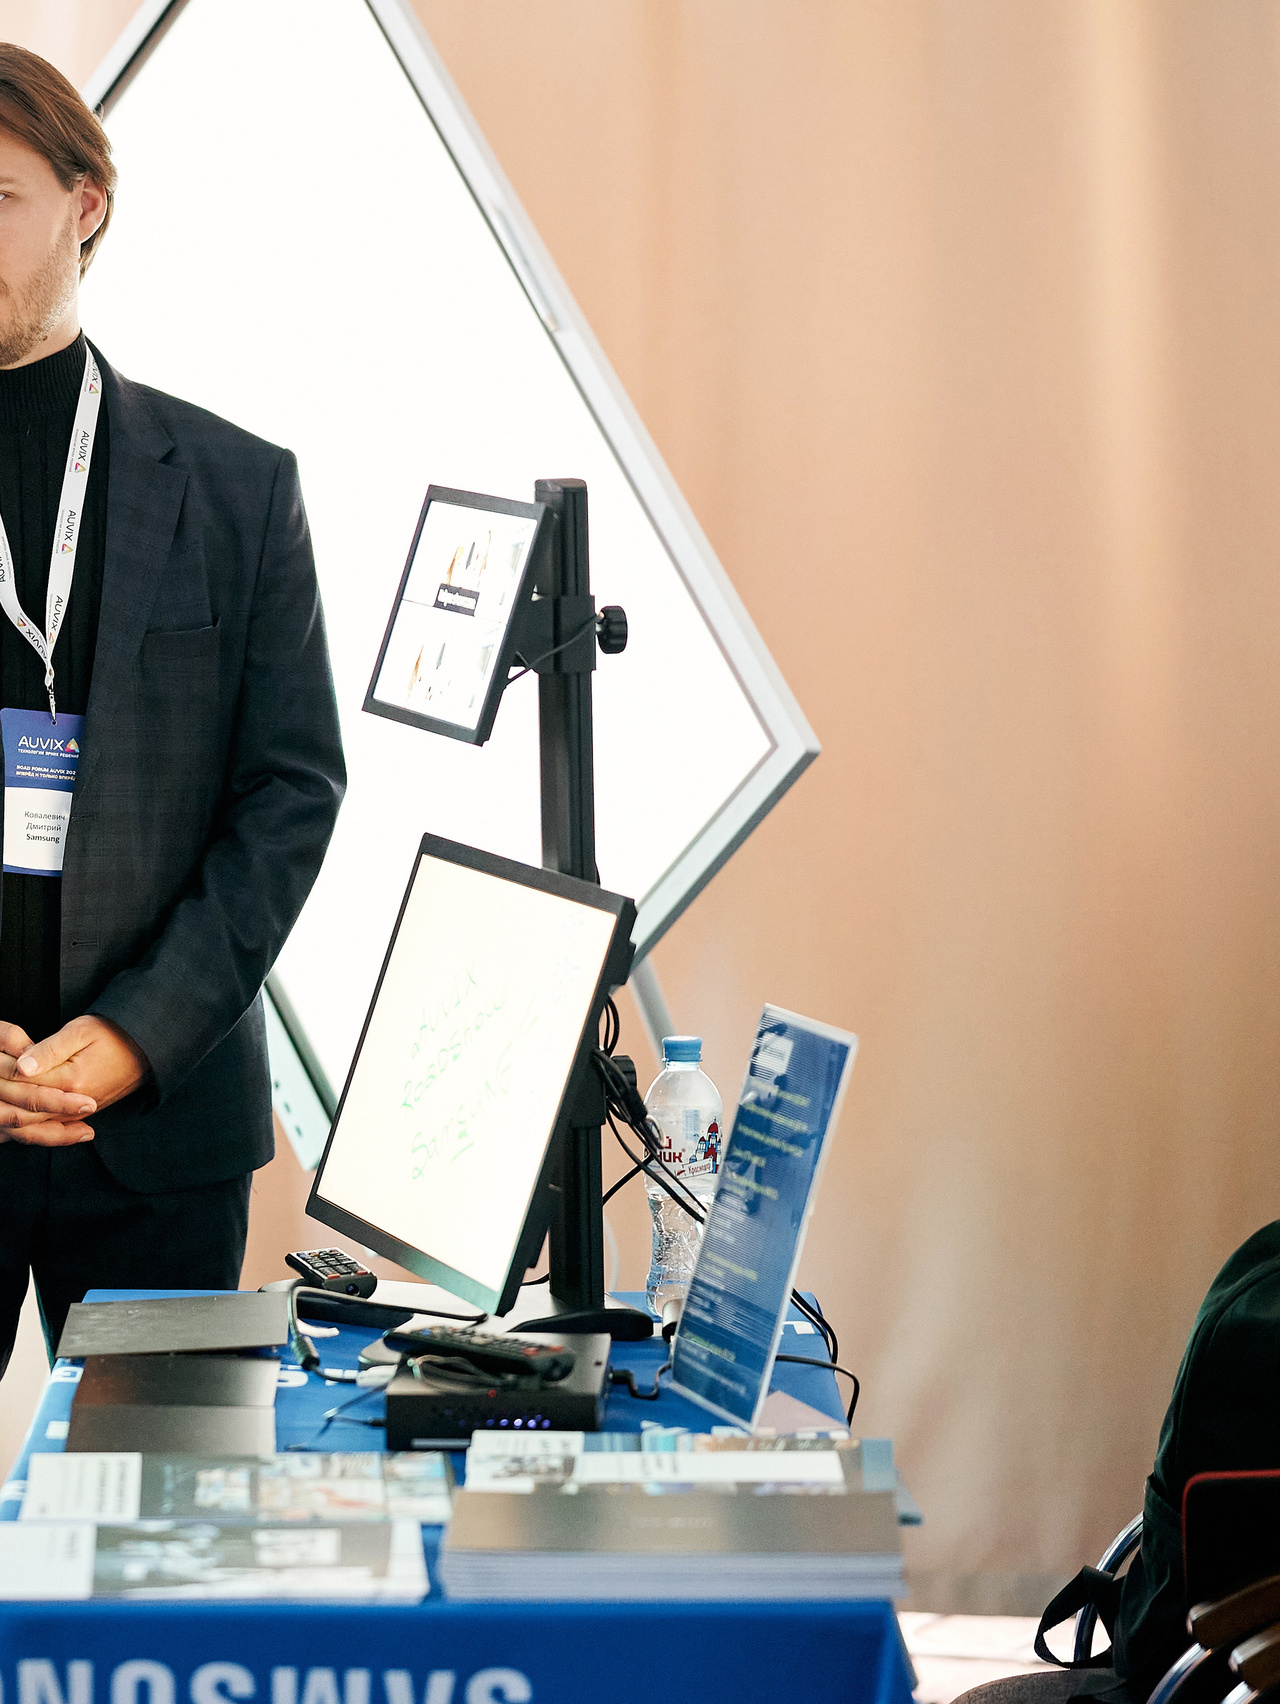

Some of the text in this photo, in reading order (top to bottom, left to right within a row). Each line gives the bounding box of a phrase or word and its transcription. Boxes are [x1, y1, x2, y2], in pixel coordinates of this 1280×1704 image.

[78, 430, 90, 461] AUVIX
[64, 509, 77, 541] AUVIX
[51, 595, 64, 631] AUVIX
[18, 735, 65, 751] AUVIX
[24, 810, 66, 822] Ковалевич
[25, 822, 62, 833] Дмитрий
[26, 833, 60, 844] Samsung
